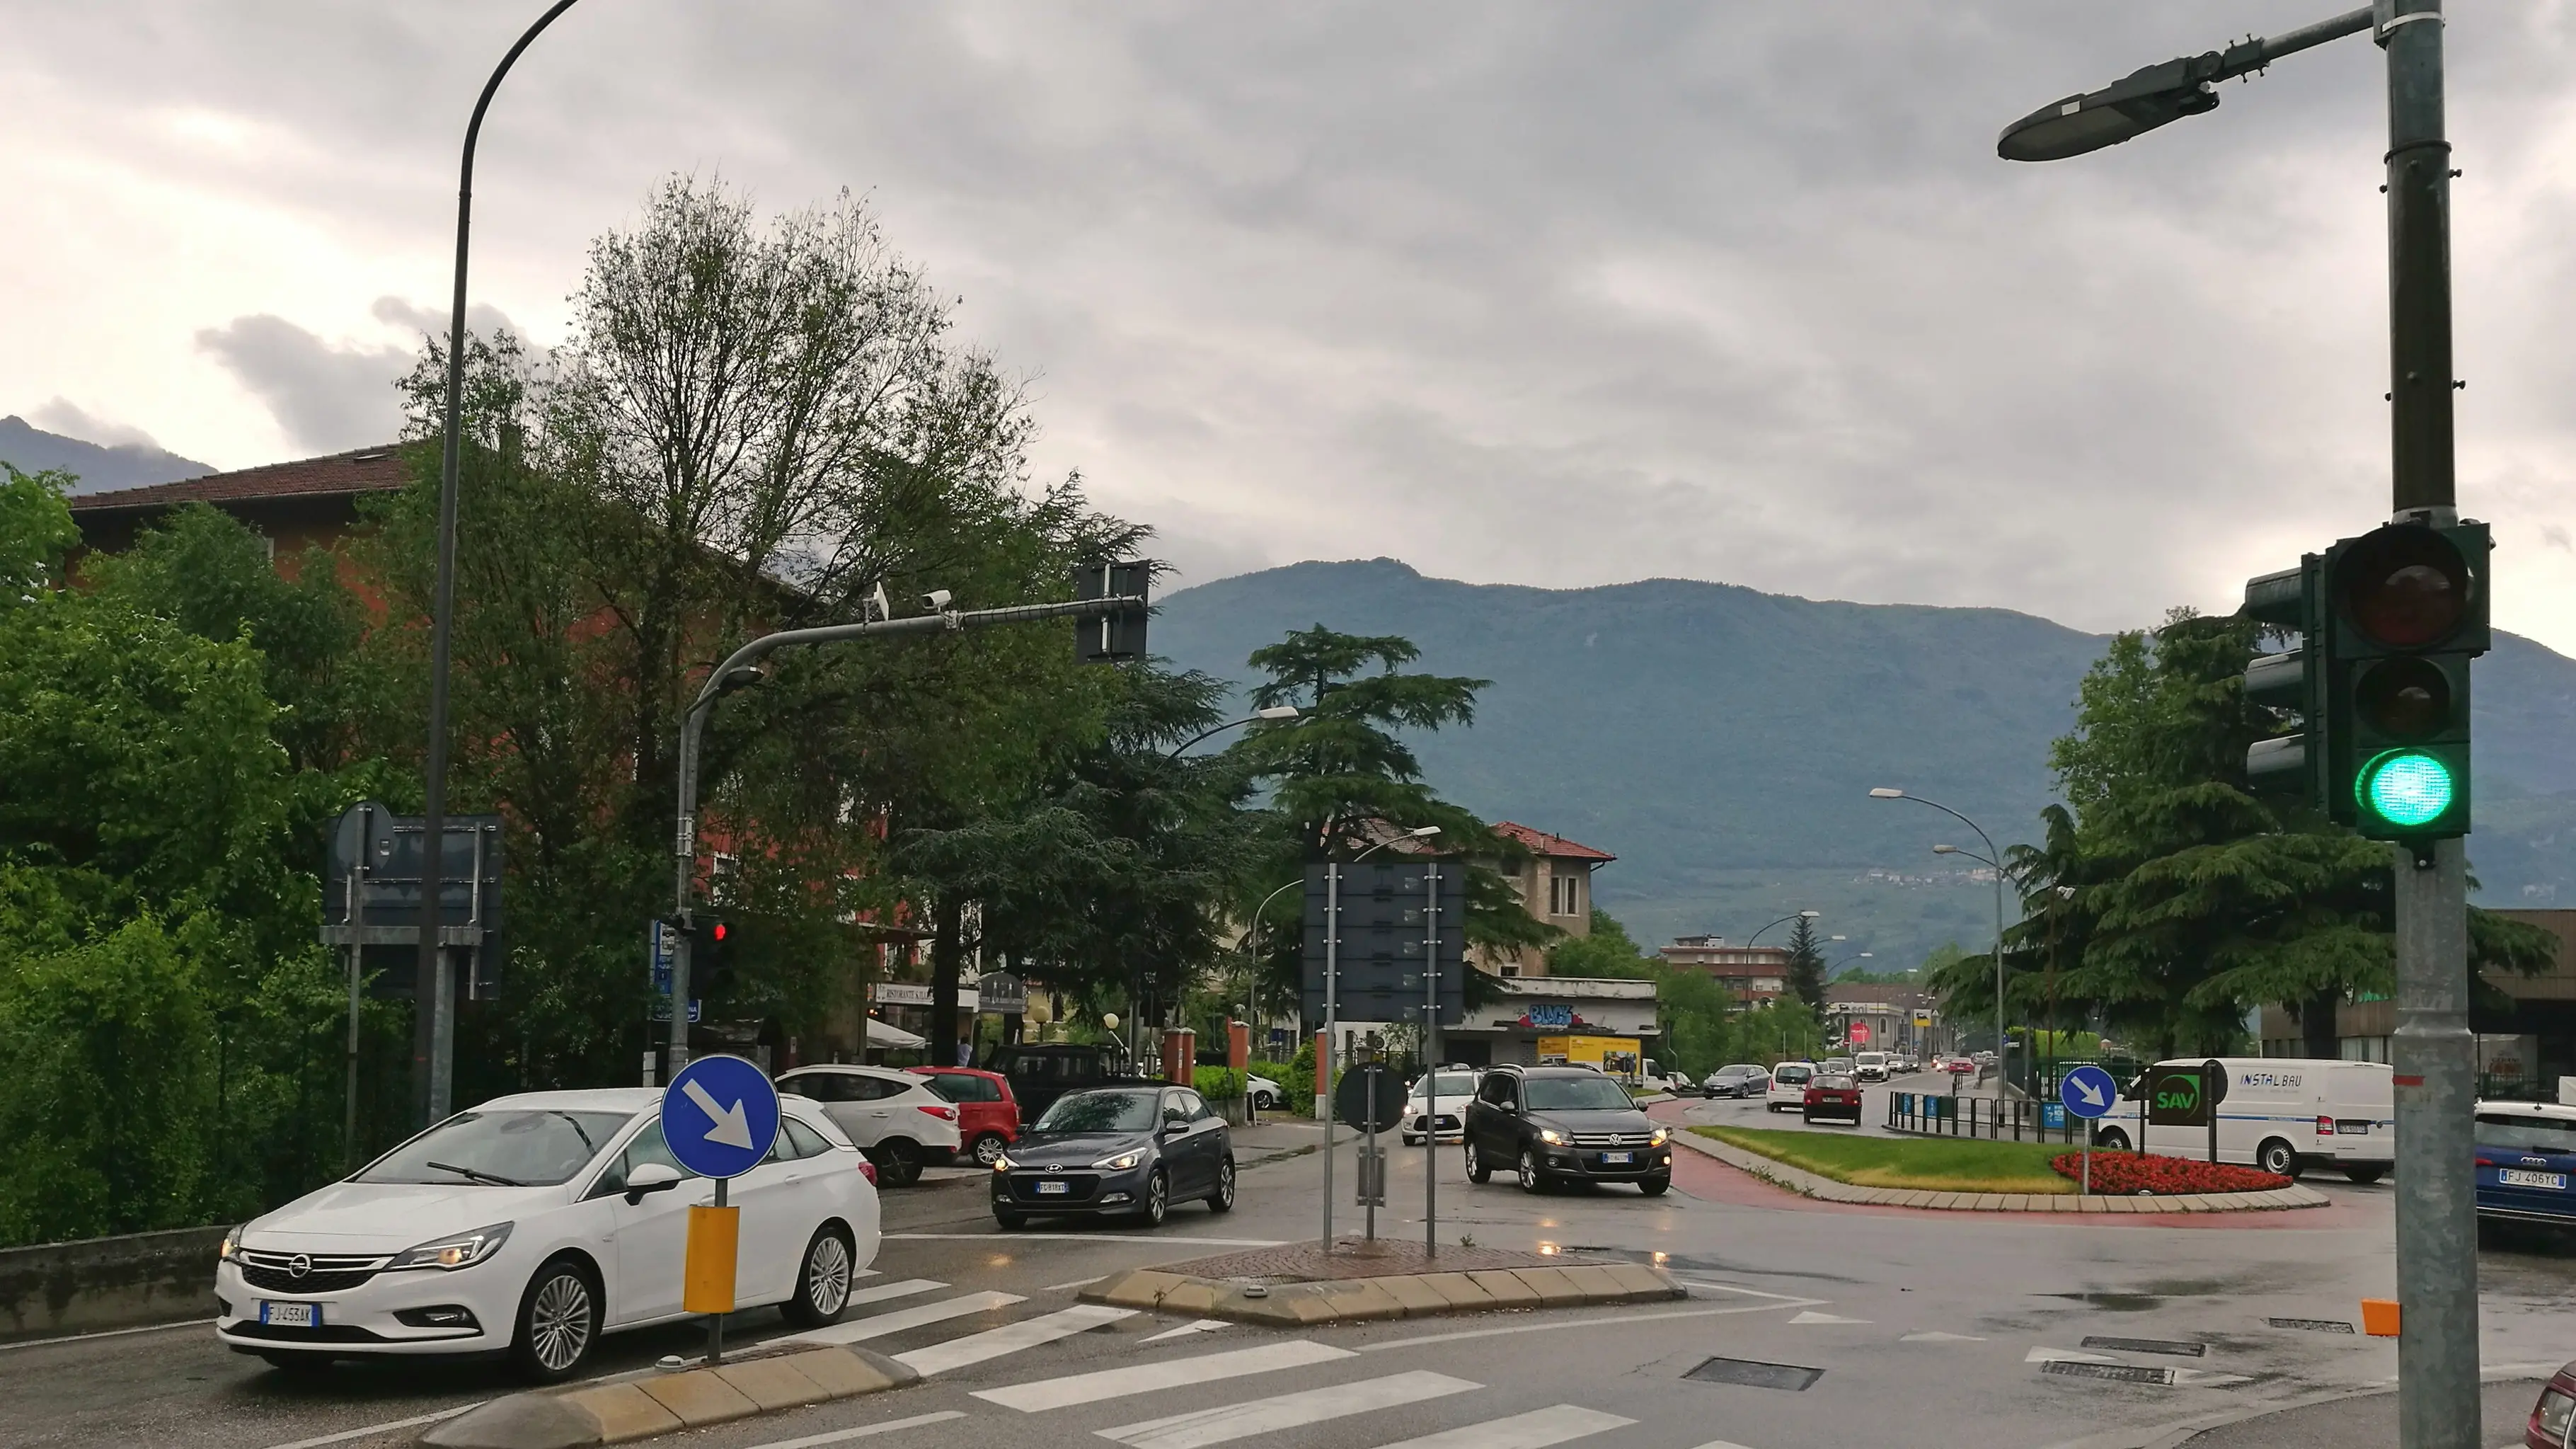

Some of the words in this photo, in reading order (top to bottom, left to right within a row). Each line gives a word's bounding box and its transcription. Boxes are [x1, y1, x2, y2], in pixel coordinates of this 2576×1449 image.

[887, 989, 915, 999] RISTORANTE
[1529, 1004, 1572, 1026] BLACK
[2240, 1073, 2279, 1086] INSTAL
[2282, 1075, 2302, 1087] BAU
[2156, 1092, 2195, 1109] SAV
